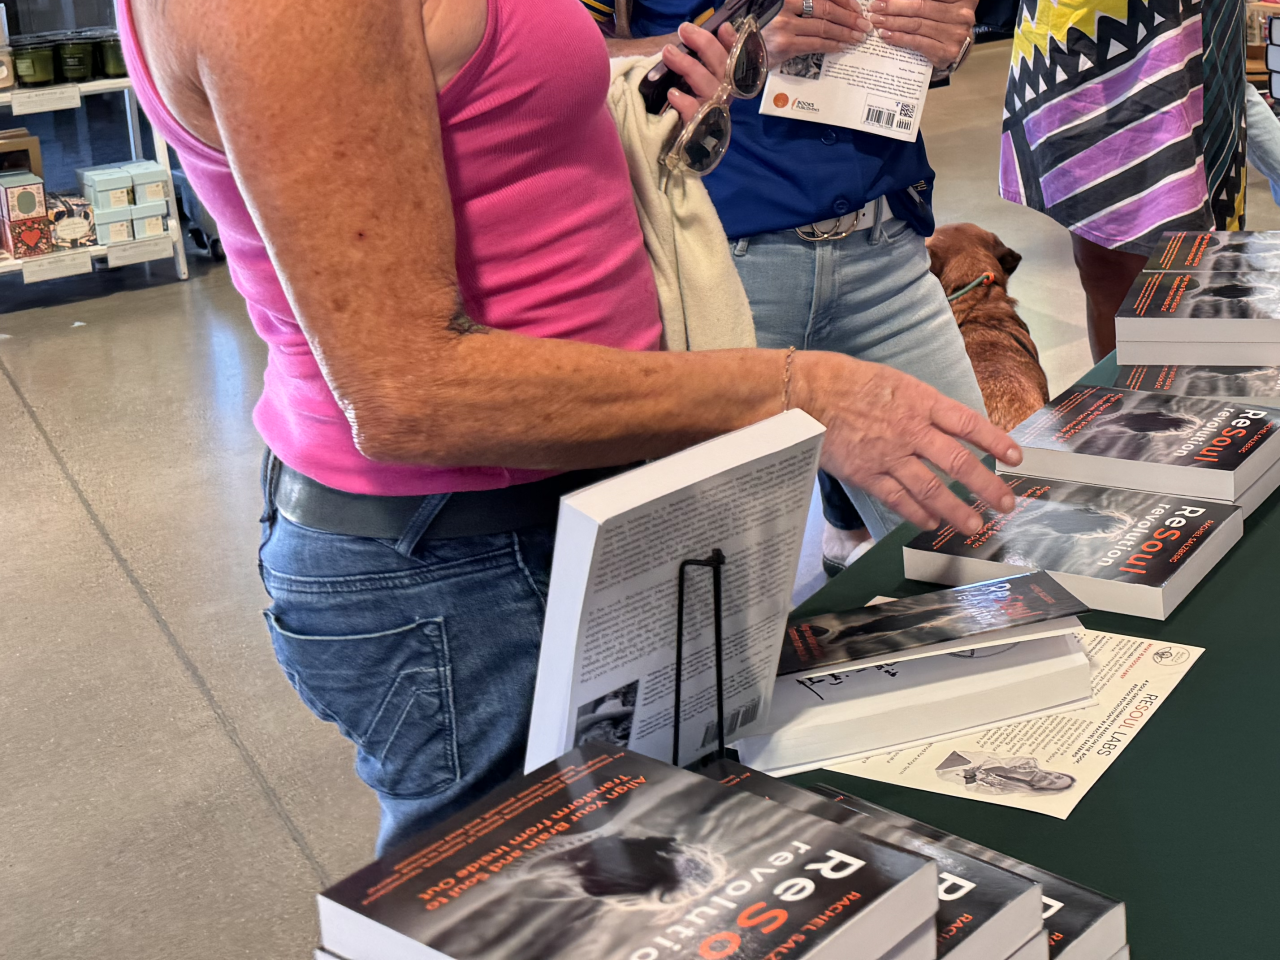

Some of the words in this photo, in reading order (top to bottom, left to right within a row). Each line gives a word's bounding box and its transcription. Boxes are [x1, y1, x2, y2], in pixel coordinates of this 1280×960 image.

[1173, 407, 1236, 458] revolution
[1193, 407, 1268, 463] ReSoul
[1096, 502, 1170, 568] revolution
[1118, 504, 1207, 575] ReSoul
[1194, 519, 1215, 543] RACHEL
[1169, 539, 1196, 564] SALZBERG
[1119, 693, 1158, 732] RESOUL
[1096, 727, 1126, 758] LABS
[552, 773, 630, 819] Transform
[605, 775, 645, 800] Align
[569, 798, 606, 821] Your
[509, 819, 552, 845] from
[521, 823, 567, 850] Brain
[455, 846, 508, 878] Inside
[489, 850, 522, 871] and
[418, 879, 454, 900] Out
[448, 871, 489, 895] Soul
[424, 897, 446, 910] to
[801, 891, 862, 931] RACHEL
